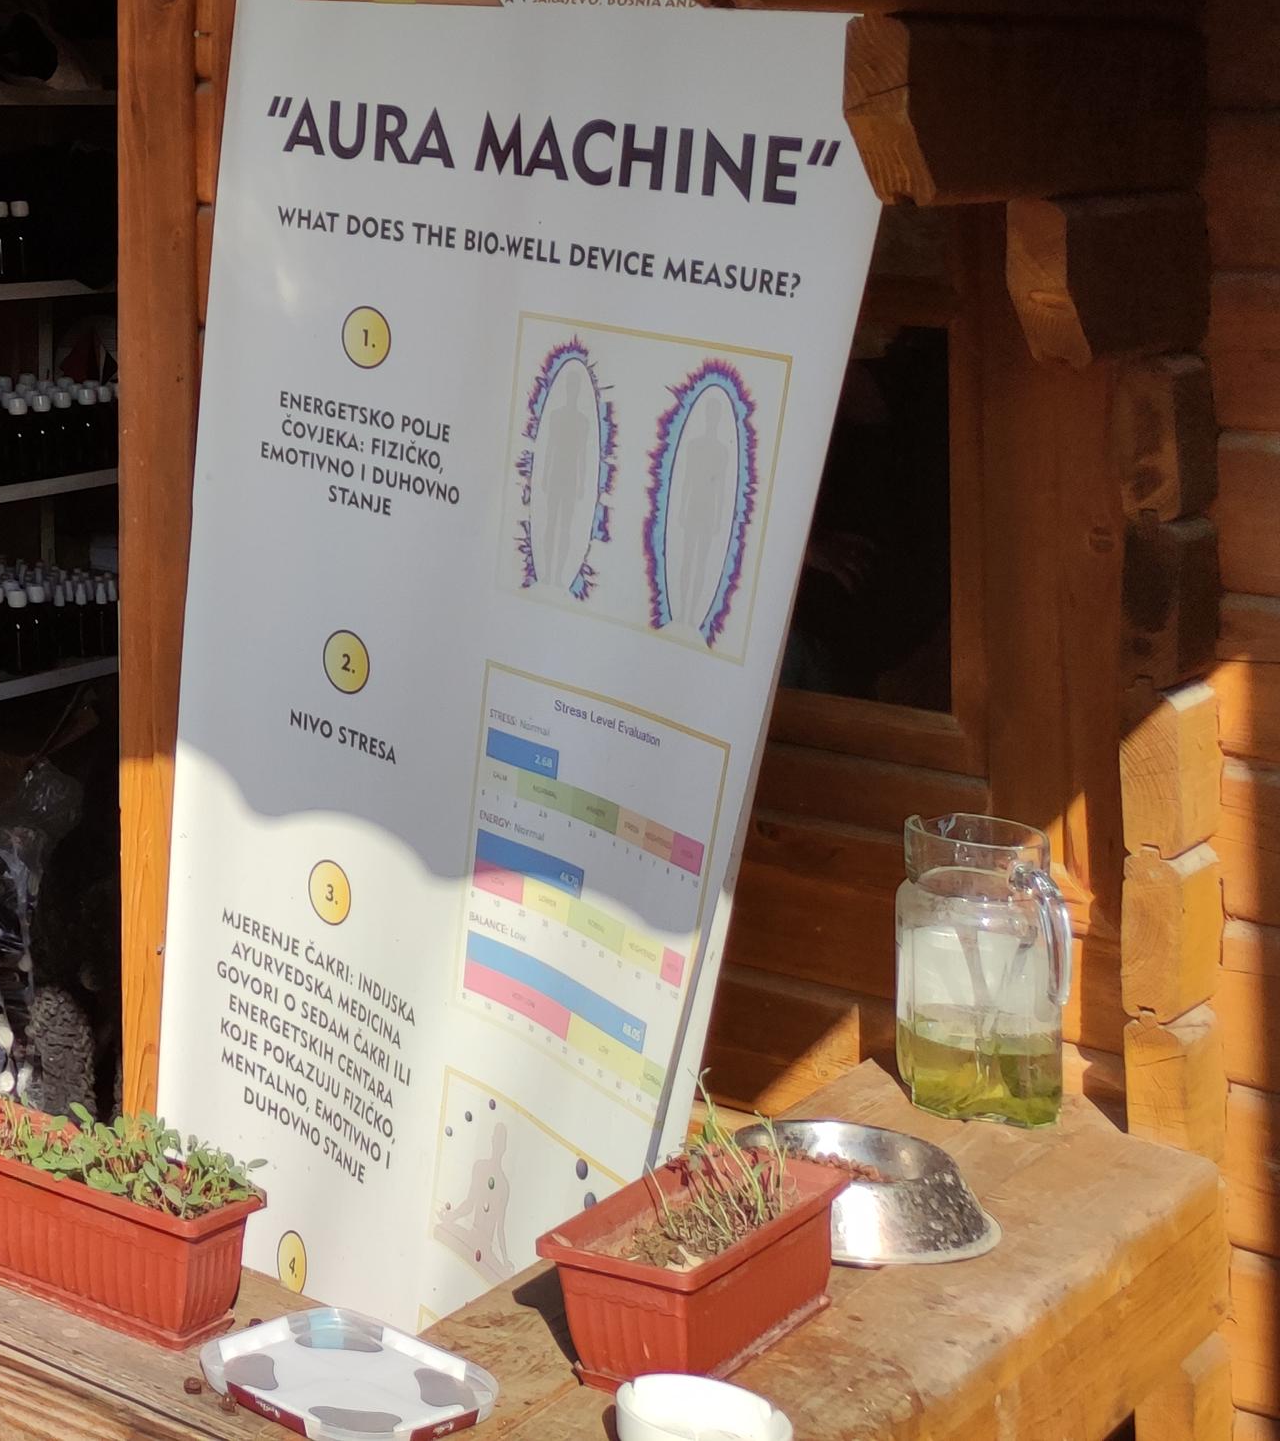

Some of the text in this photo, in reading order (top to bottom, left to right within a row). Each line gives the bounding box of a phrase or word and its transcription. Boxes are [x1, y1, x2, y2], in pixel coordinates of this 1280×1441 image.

[278, 206, 801, 298] WHAT DOES THE BIO-WELL DEVICE MEASURE?
[362, 328, 376, 349] 1.
[280, 390, 451, 443] ENERGETSKO POLJE
[282, 413, 444, 475] ČOVJEKA: FIZIČKO,
[261, 441, 460, 505] EMOTIVNO I DUHOVNO
[328, 485, 392, 516] STANJE
[341, 653, 356, 674] 2.
[290, 708, 397, 765] NIVO STRESA
[519, 719, 551, 738] Normal
[554, 699, 661, 749] Stress Level Evaluation
[514, 822, 545, 843] Normal
[325, 883, 339, 906] 3.
[222, 907, 300, 957] MJERENJE
[304, 939, 354, 986] ČAKRI:
[358, 972, 416, 1027] INDIJSKA
[231, 940, 334, 1005] AYURVEDSKA
[337, 991, 401, 1049] MEDICINA
[217, 960, 412, 1086] GOVORI O SEDAM ČAKRI ILI
[229, 993, 394, 1109] ENERGETSKIH CENTARA
[220, 1017, 396, 1145] KOJE POKAZUJU FIZIČKO,
[221, 1047, 391, 1169] MENTALNO, EMOTIVNO I
[243, 1086, 366, 1184] DUHOVNO STANJE
[288, 1256, 298, 1279] 4.
